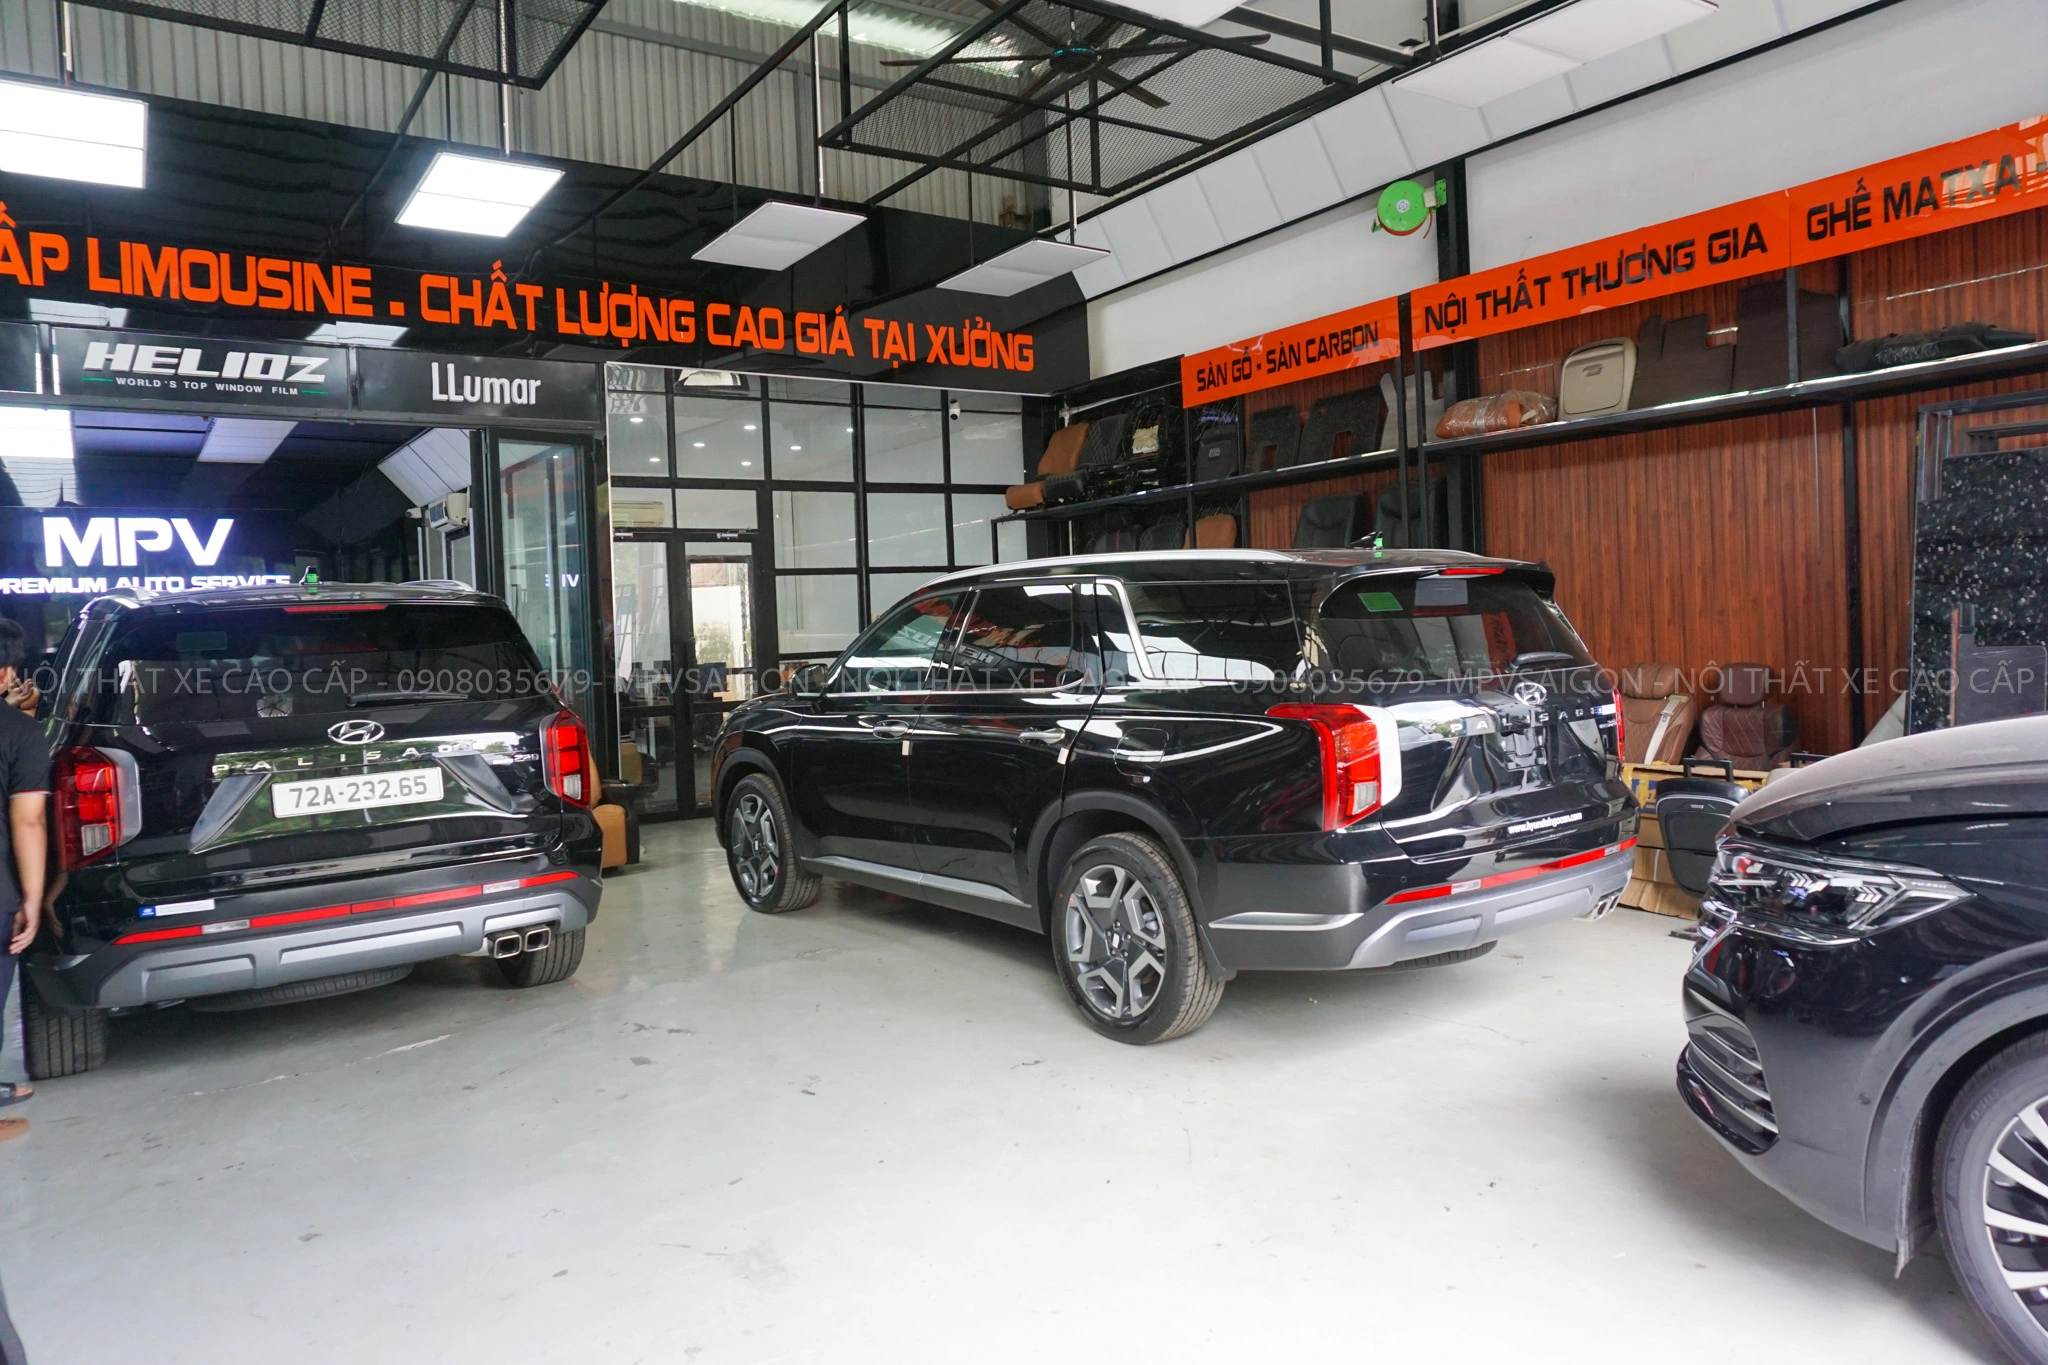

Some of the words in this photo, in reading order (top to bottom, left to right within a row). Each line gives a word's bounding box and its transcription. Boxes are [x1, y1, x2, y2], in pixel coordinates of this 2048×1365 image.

[1807, 177, 1872, 241] GHẾ
[1884, 154, 2022, 223] MATXA
[1424, 291, 1467, 336] NỘI
[1476, 263, 1552, 321] THẤT
[1561, 238, 1696, 299] THƯƠNG
[1708, 221, 1768, 265] GIA
[87, 237, 373, 317] LIMOUSINE
[420, 260, 544, 331] CHẤT
[556, 282, 696, 348] LƯỢNG
[706, 303, 784, 350] CAO
[796, 305, 854, 357] GIÁ
[864, 319, 916, 369] TẠI
[926, 315, 1034, 372] XƯỞNG
[82, 341, 330, 384] HELIOZ
[1197, 361, 1228, 393] SÀN
[1231, 345, 1253, 383] GỖ
[1266, 341, 1301, 375] SÀN
[1305, 320, 1379, 365] CARBON
[183, 380, 208, 390] TOP
[215, 383, 263, 393] WINDOW
[271, 386, 299, 395] FILM
[431, 362, 541, 406] LLumar
[42, 516, 235, 567] MPV
[0, 577, 107, 594] REMIUM
[289, 776, 428, 808] 72A-232.65
